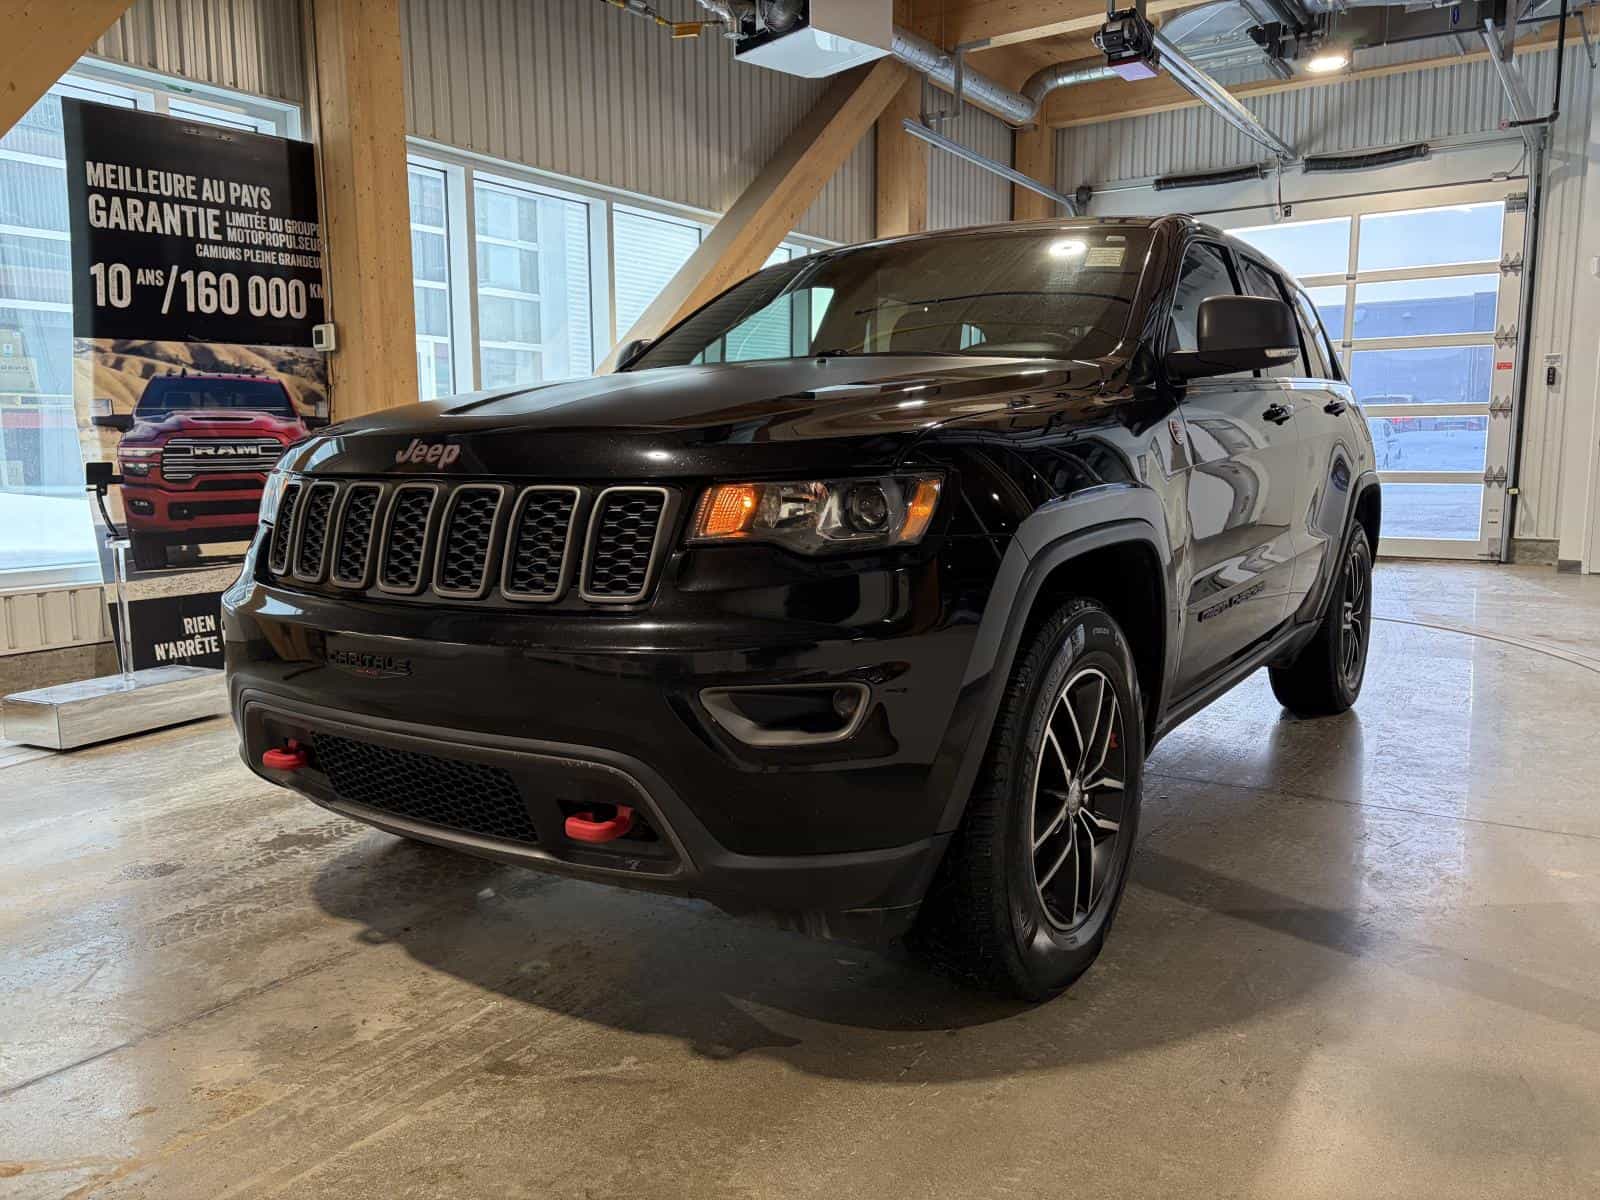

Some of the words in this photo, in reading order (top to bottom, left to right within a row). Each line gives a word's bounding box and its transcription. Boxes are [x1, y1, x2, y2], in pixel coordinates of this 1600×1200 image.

[86, 160, 198, 200] MEILLEURE
[202, 178, 226, 203] AU
[229, 182, 272, 210] PAYS
[88, 193, 222, 241] GARANTIE
[225, 210, 267, 231] LIMITÉE
[269, 216, 283, 233] DU
[195, 243, 242, 261] CAMIONS
[244, 248, 277, 265] PLEINE
[278, 252, 321, 269] GRANDEU
[89, 262, 132, 308] 10
[136, 267, 165, 287] ANS
[248, 274, 307, 319] 000
[194, 445, 258, 456] RAM
[395, 438, 461, 470] Jeep
[183, 614, 216, 635] RIEN
[154, 634, 220, 662] N'ARRÊTE
